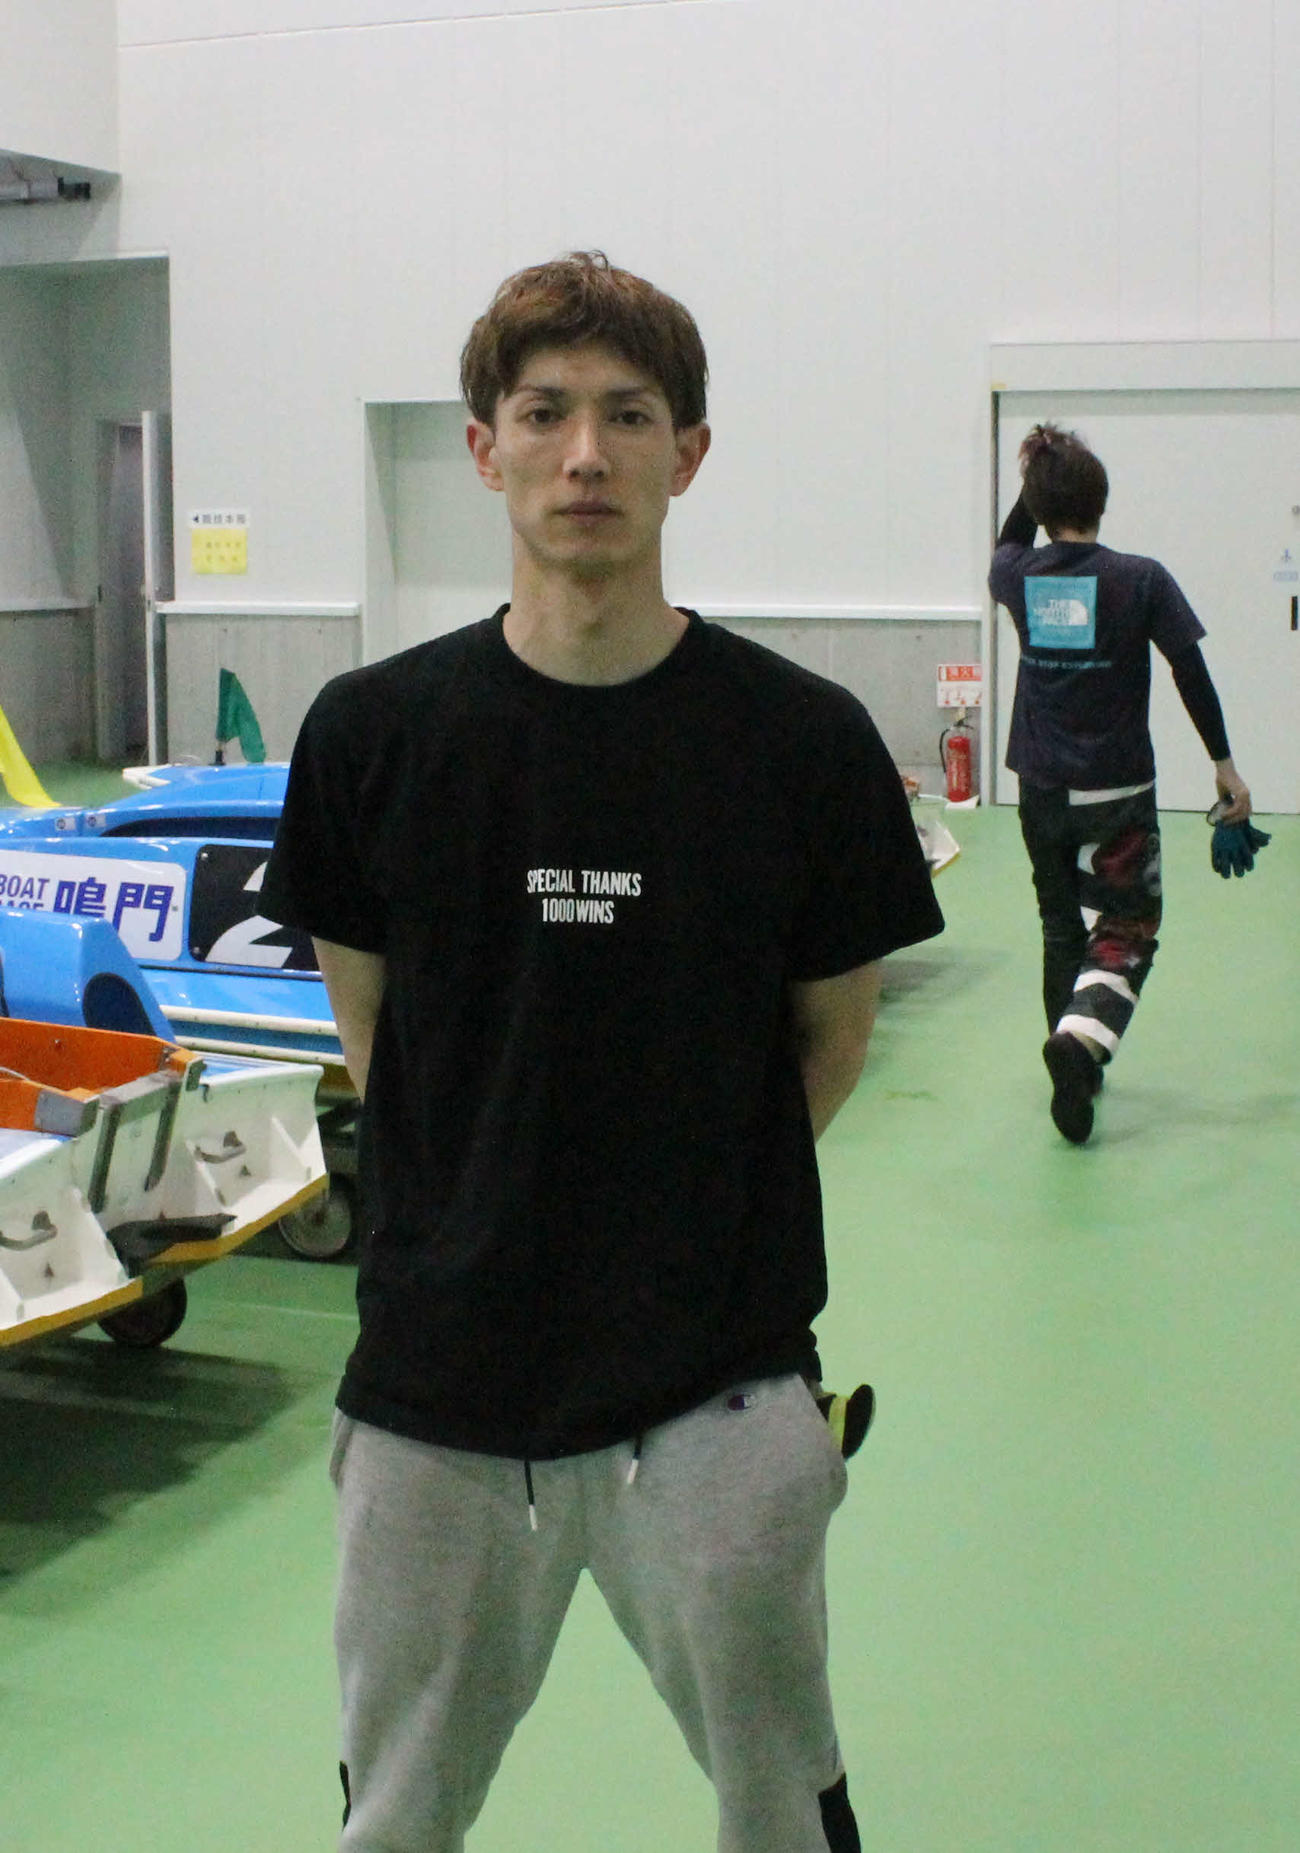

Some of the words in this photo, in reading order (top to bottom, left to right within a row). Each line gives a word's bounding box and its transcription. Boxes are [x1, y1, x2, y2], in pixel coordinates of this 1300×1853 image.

[527, 868, 576, 893] SPECIAL
[581, 870, 642, 897] THANKS
[53, 877, 174, 942] 鳴門
